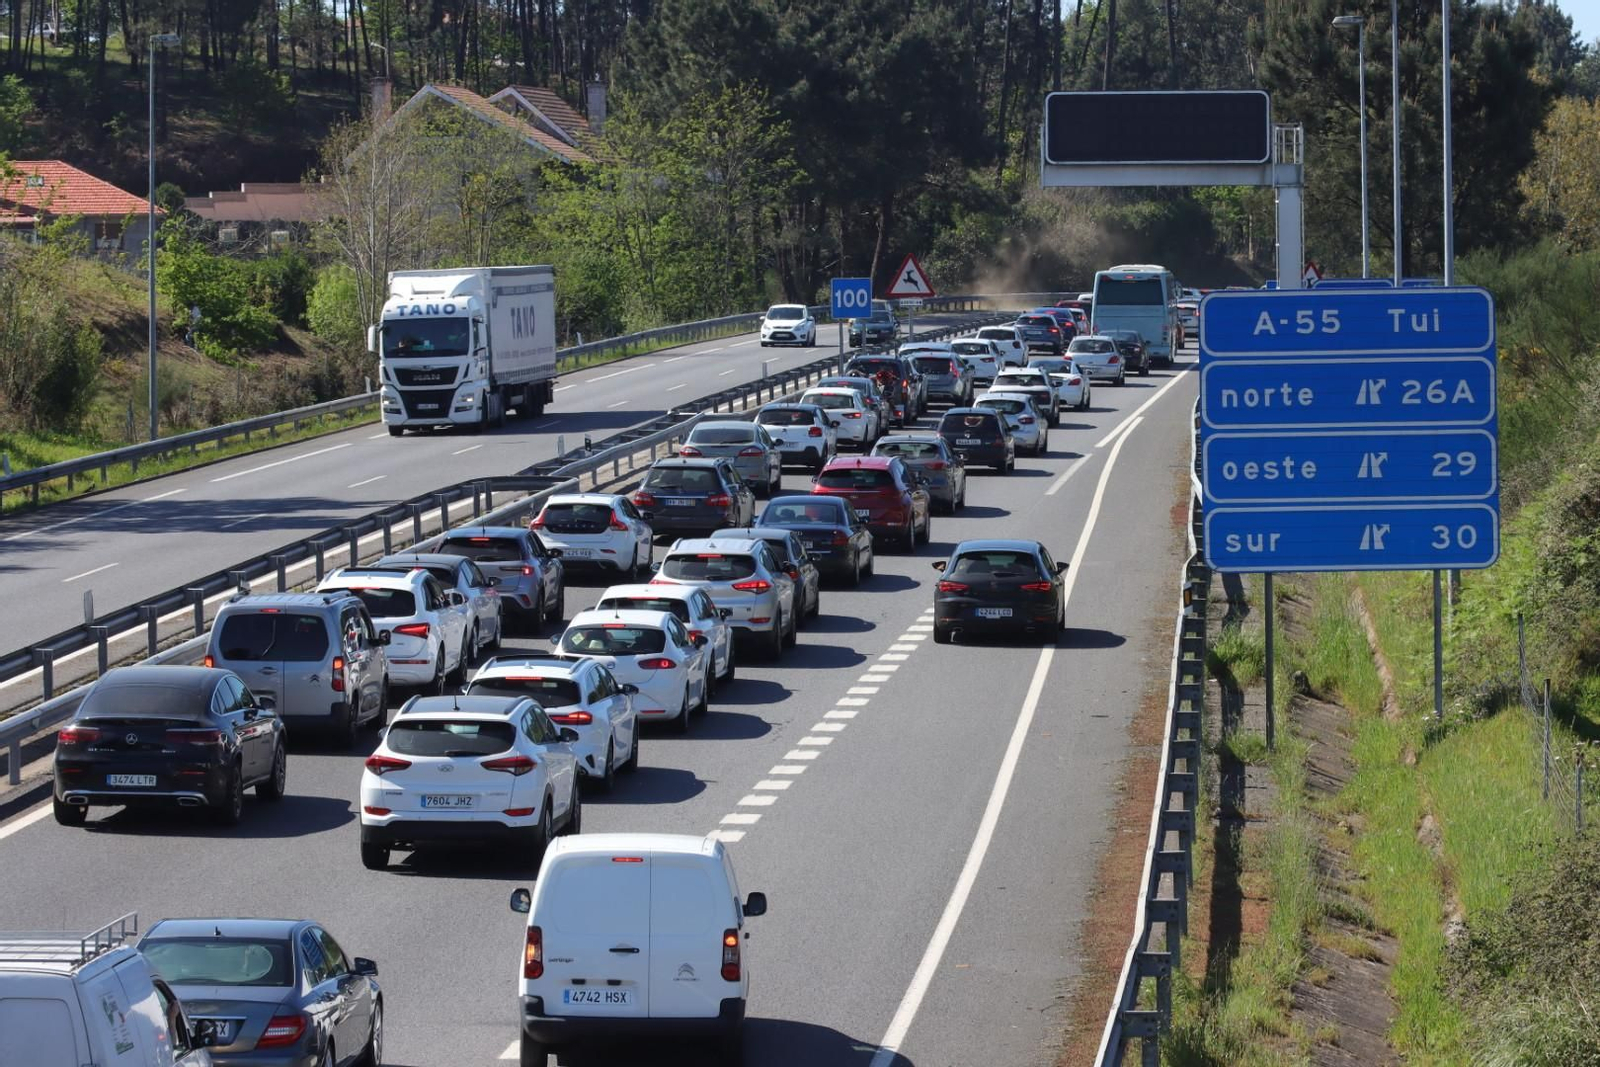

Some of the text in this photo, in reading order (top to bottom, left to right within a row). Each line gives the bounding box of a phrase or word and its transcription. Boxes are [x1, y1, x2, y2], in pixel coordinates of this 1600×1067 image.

[396, 303, 457, 316] TANO
[835, 288, 868, 308] 100
[510, 305, 536, 339] TANO
[1253, 308, 1440, 335] A-55 Tui
[1221, 379, 1476, 408] norte 26A
[1222, 452, 1477, 480] oeste 29
[1225, 525, 1477, 552] sur 30
[112, 775, 155, 785] 3474 LTR
[427, 796, 472, 806] 7604 JHZ
[572, 991, 627, 1003] 4742 HSX
